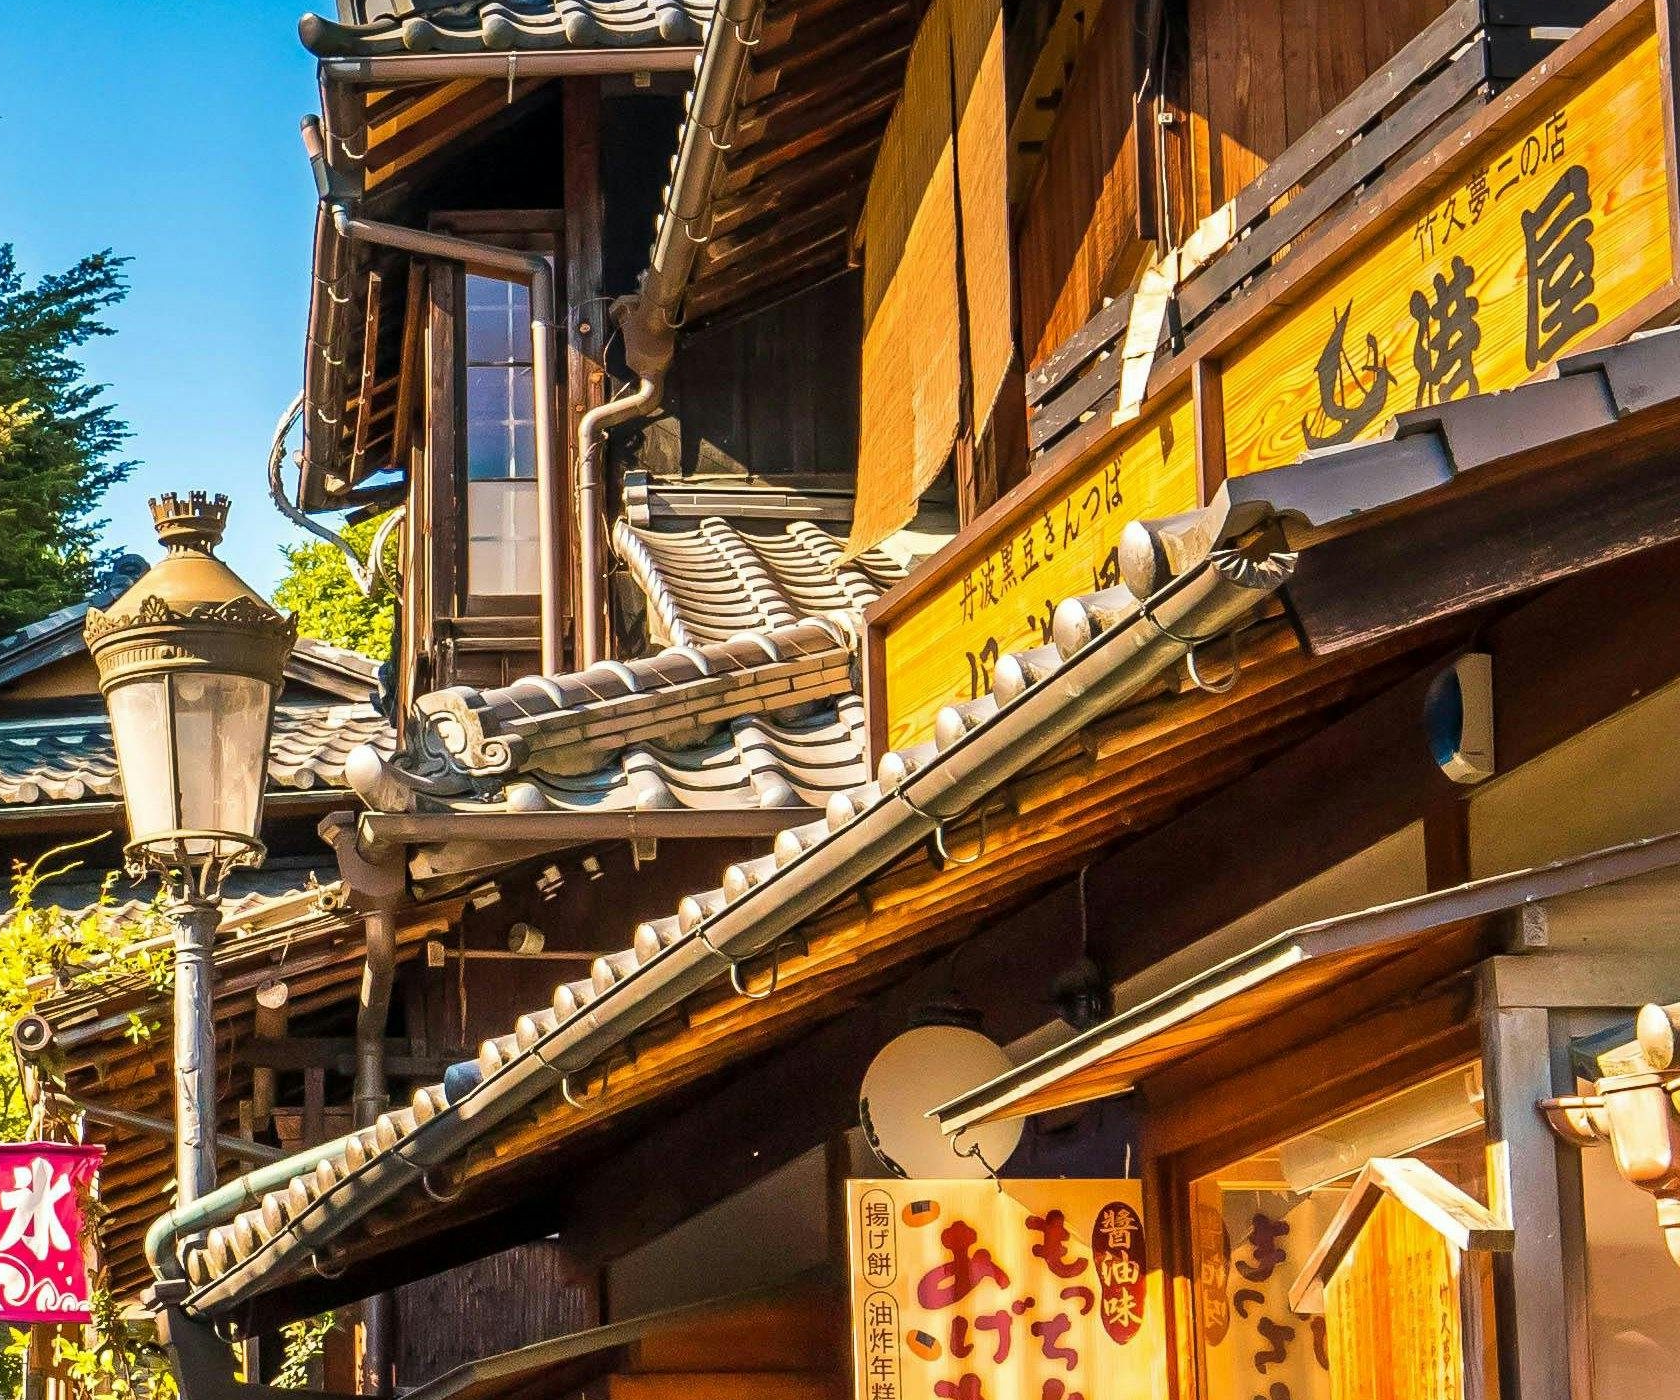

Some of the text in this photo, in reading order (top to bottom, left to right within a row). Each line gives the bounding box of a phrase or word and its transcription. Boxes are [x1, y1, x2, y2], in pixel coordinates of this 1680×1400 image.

[1413, 109, 1569, 263] 竹久夢二の店
[958, 453, 1124, 626] 丹波黒豆きんつば
[865, 1202, 891, 1277] 揚げ餅
